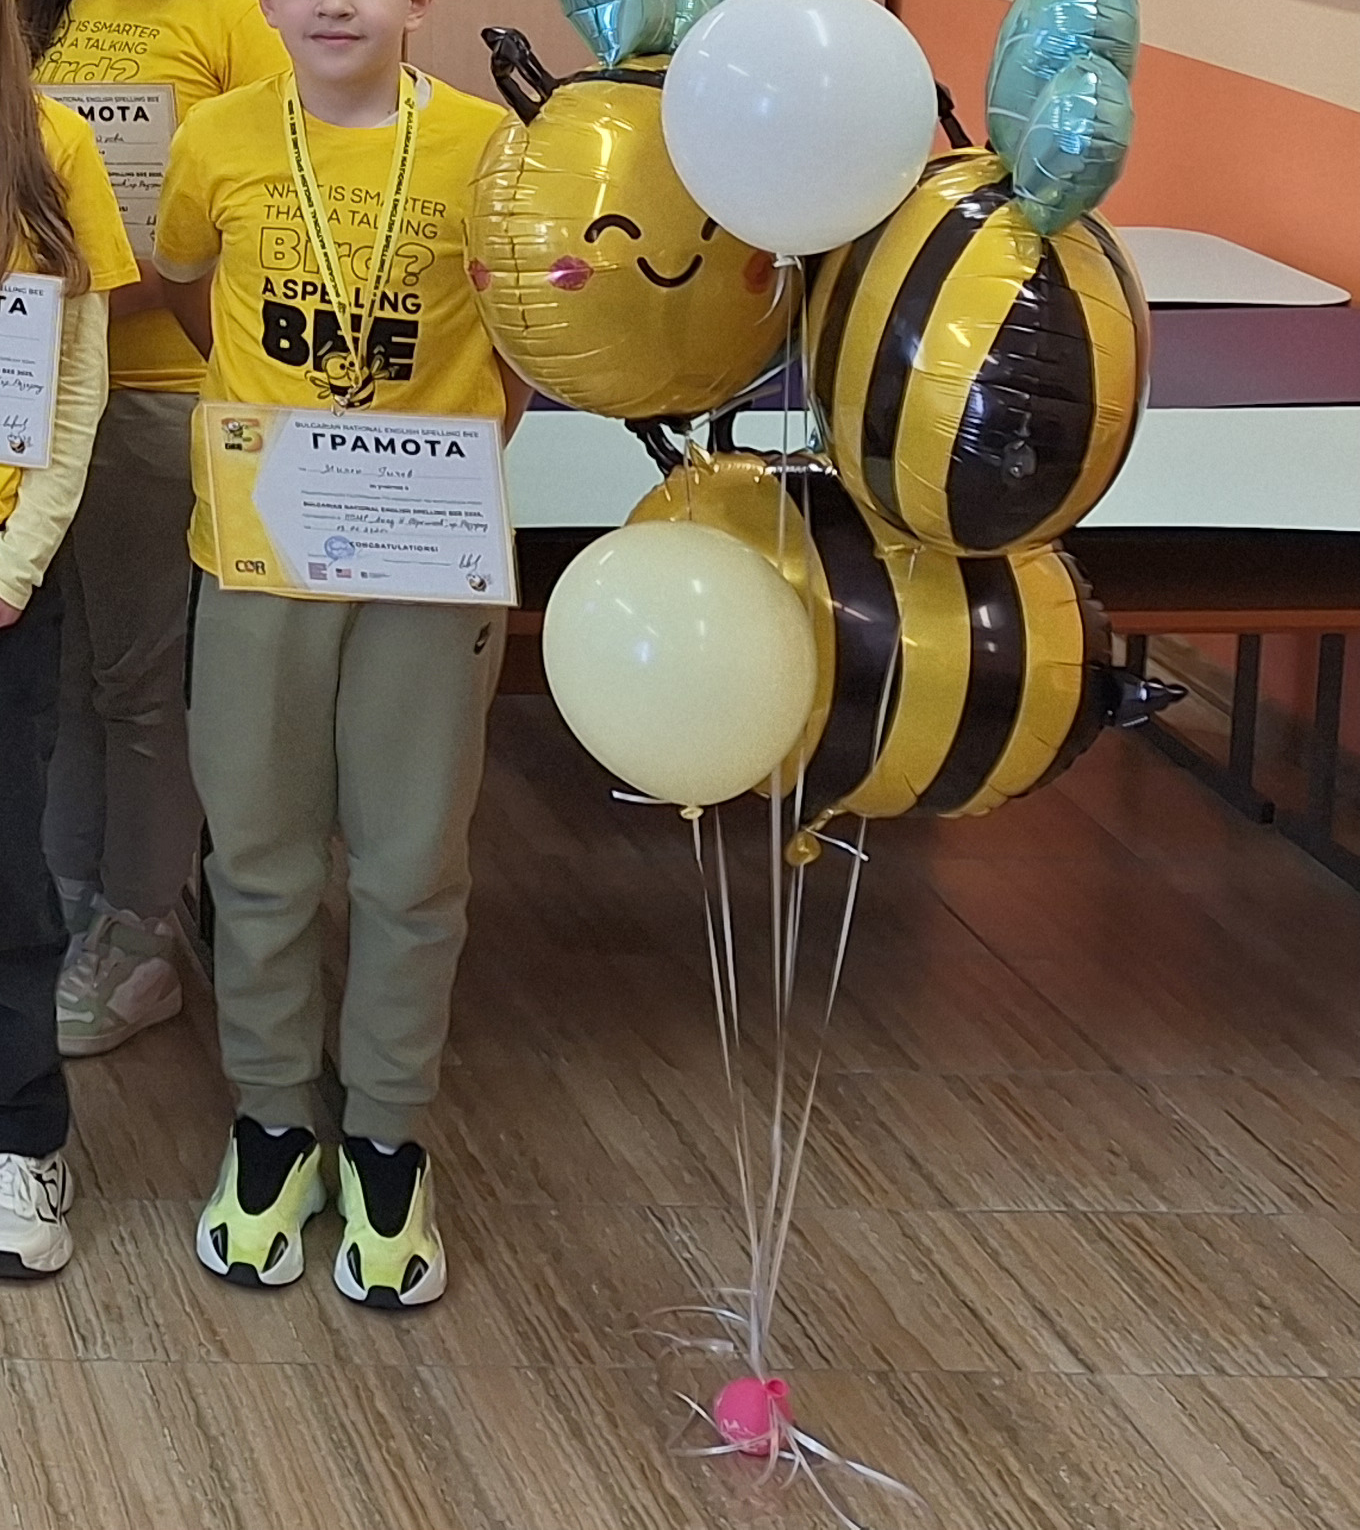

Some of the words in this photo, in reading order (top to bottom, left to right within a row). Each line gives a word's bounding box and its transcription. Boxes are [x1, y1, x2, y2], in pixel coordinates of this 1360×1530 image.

[76, 20, 88, 32] IS
[90, 22, 160, 38] SMARTER
[69, 38, 79, 48] A
[84, 38, 148, 54] TALKING
[78, 106, 149, 121] МОТА
[264, 183, 325, 199] WHT
[329, 185, 345, 201] IS
[350, 188, 446, 217] SMTER
[264, 205, 308, 221] THA
[329, 208, 340, 224] A
[348, 211, 438, 239] TALING
[262, 276, 276, 297] A
[283, 278, 422, 314] SPELNG
[262, 299, 418, 381] BEE
[312, 432, 466, 458] ГРАМОТА
